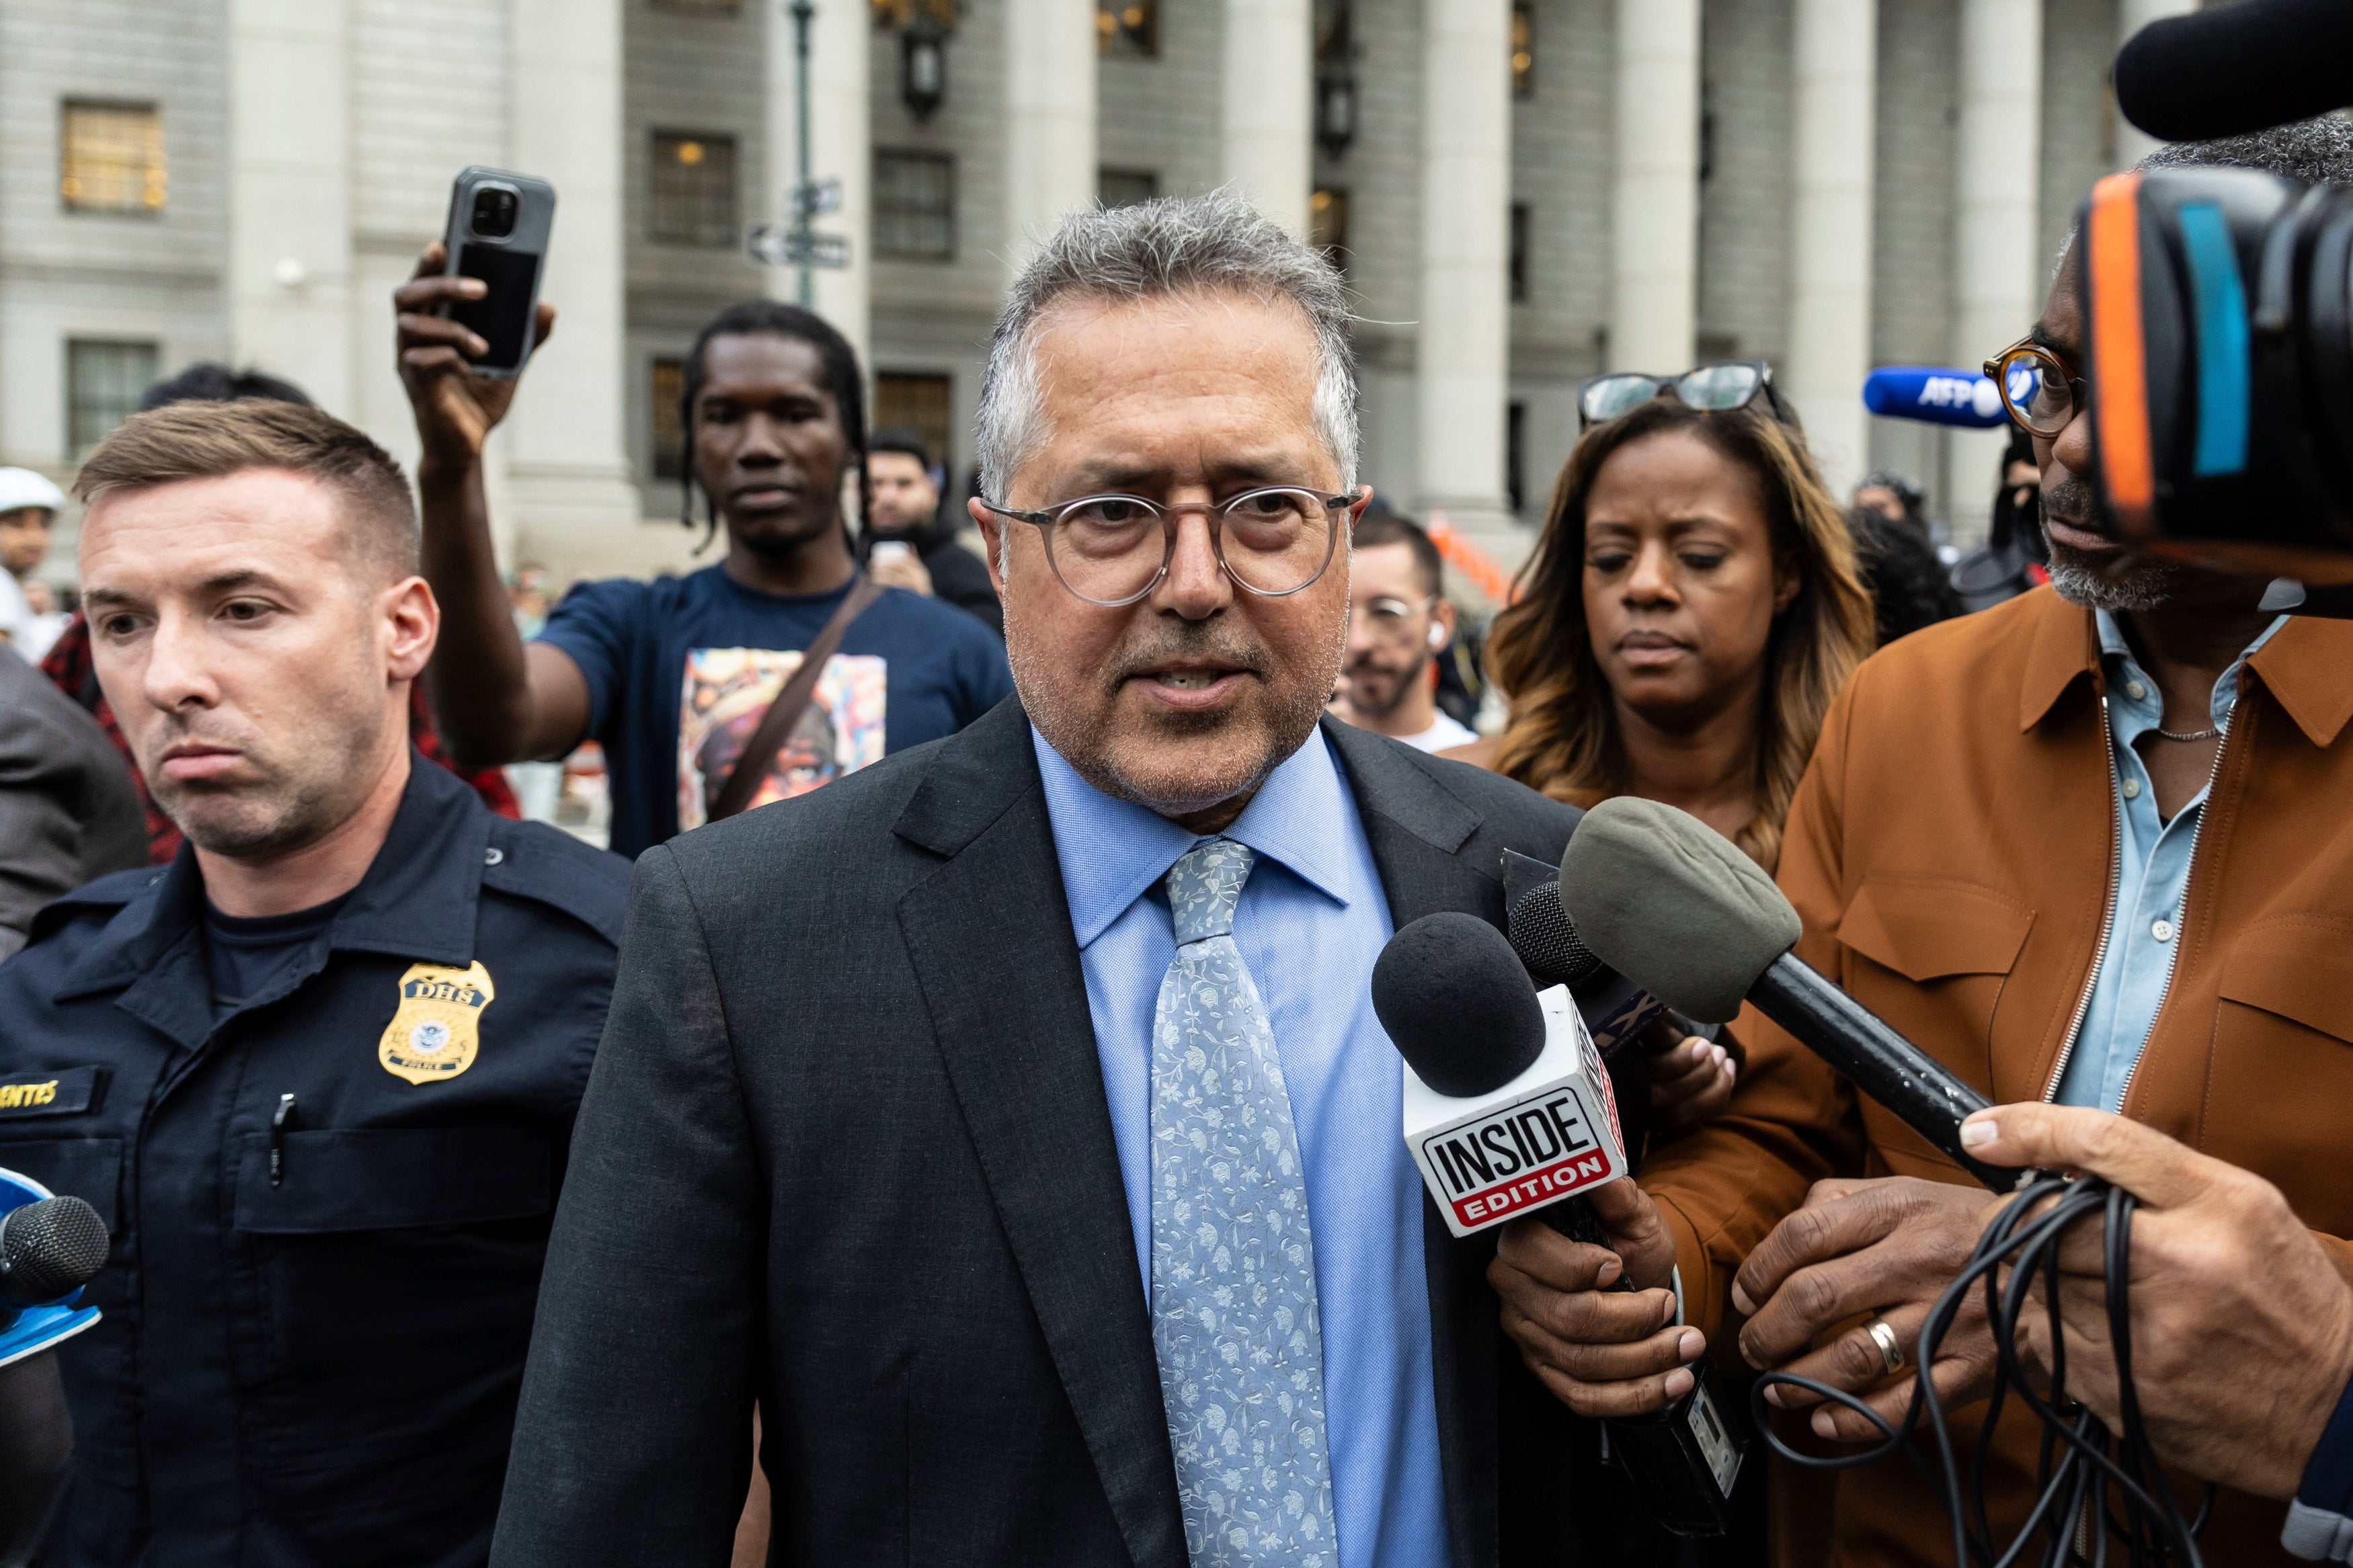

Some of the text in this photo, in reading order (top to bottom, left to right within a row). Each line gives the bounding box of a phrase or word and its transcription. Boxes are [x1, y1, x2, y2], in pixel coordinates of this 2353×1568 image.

[1918, 377, 1973, 409] AFP
[415, 983, 475, 1005] DHS
[1434, 1098, 1590, 1194] INSIDE
[1464, 1156, 1603, 1221] EDITION
